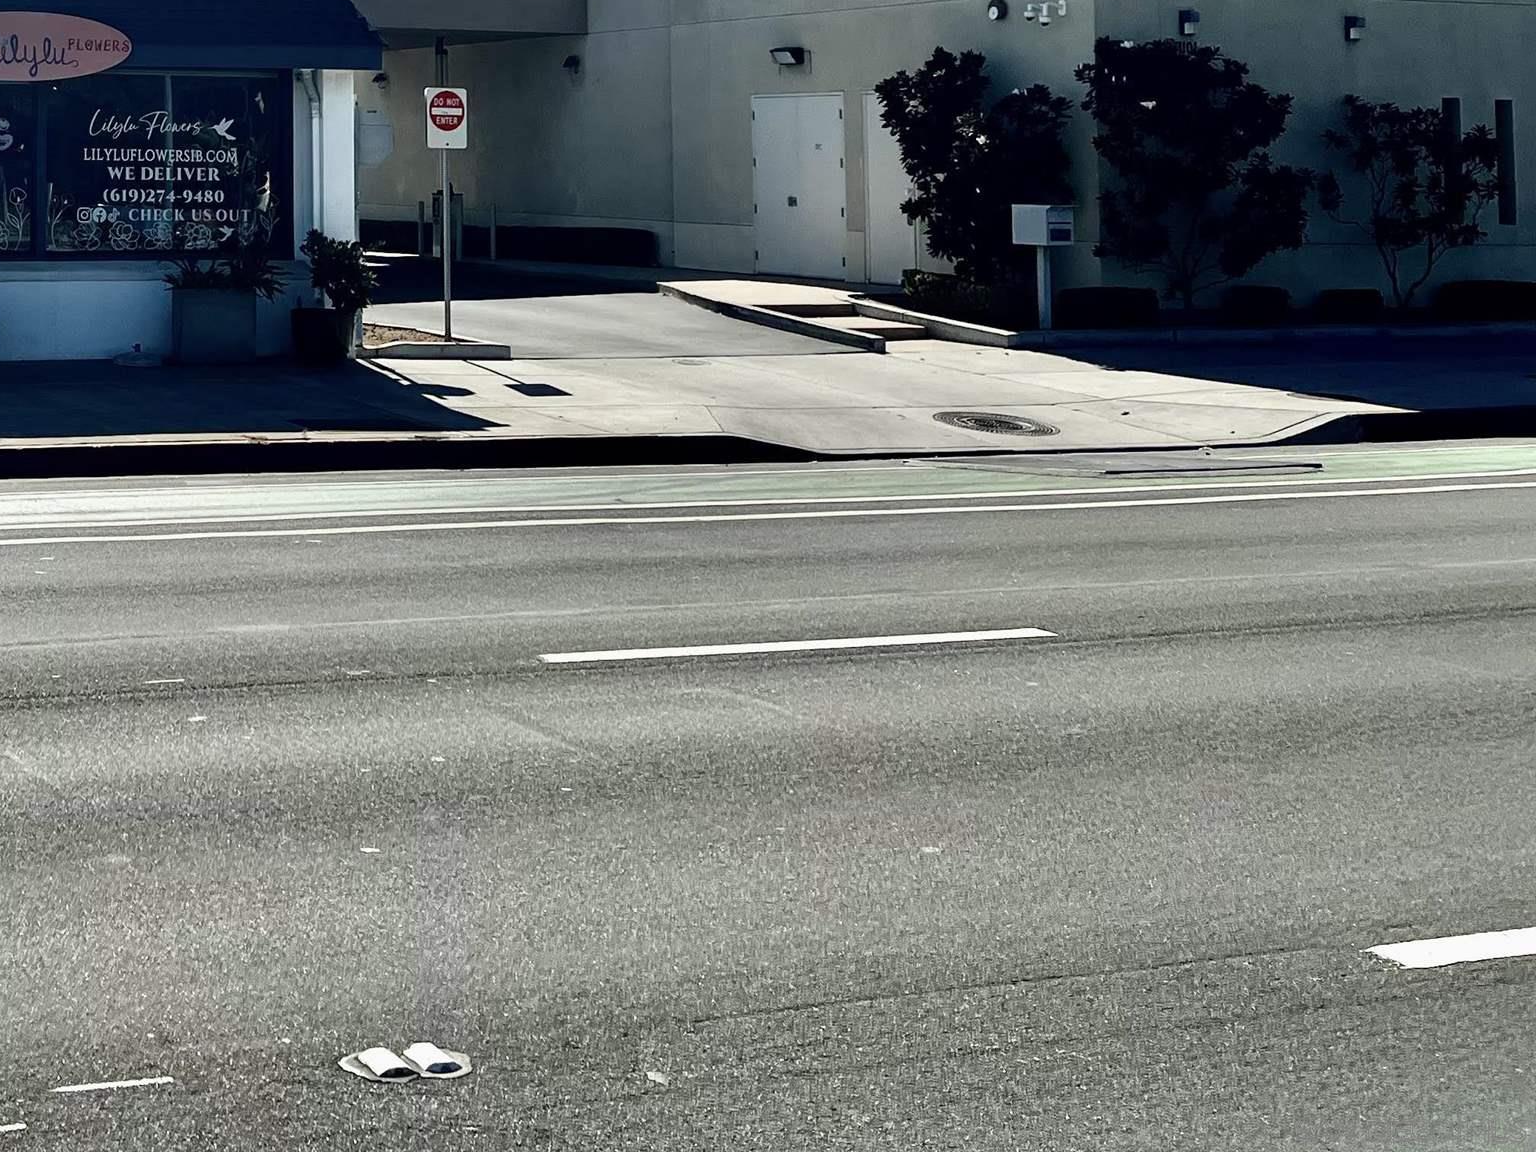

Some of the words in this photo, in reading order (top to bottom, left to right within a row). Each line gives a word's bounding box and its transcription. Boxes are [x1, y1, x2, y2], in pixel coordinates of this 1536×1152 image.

[68, 38, 129, 53] FLOWERS
[434, 98, 444, 106] DO
[446, 98, 460, 106] NOT
[89, 109, 139, 139] Lilylu
[139, 111, 203, 140] Flowers
[436, 117, 458, 125] ENTER
[84, 148, 238, 163] LILYLUFLOWERSIB.COM
[107, 167, 135, 181] WE
[141, 167, 220, 182] DELIVER
[103, 189, 224, 204] (619)274-9480
[128, 209, 184, 222] CHECK
[192, 209, 212, 222] US
[216, 209, 251, 222] OUT
